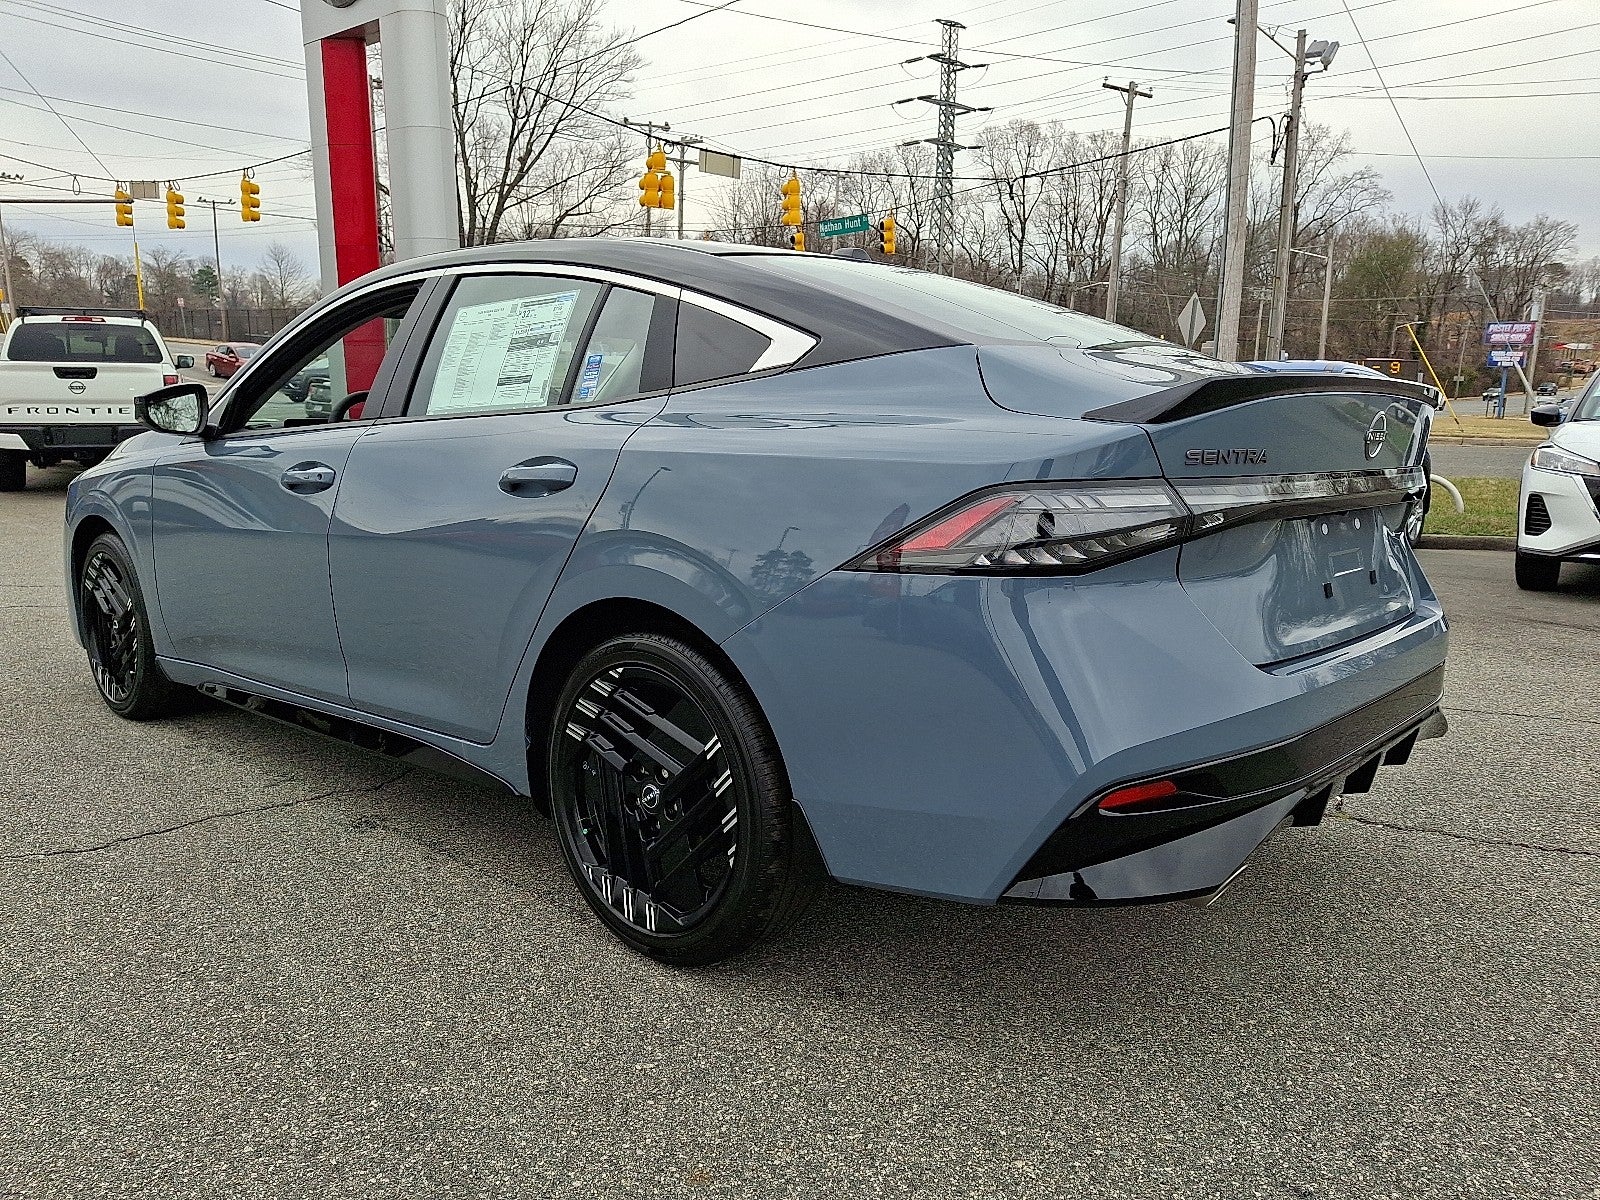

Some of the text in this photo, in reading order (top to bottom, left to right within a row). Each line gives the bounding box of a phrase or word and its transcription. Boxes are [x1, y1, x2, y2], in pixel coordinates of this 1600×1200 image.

[820, 222, 842, 233] Nathan
[844, 217, 861, 229] Hunt
[1390, 361, 1401, 374] 9
[1184, 448, 1268, 466] SENTRA
